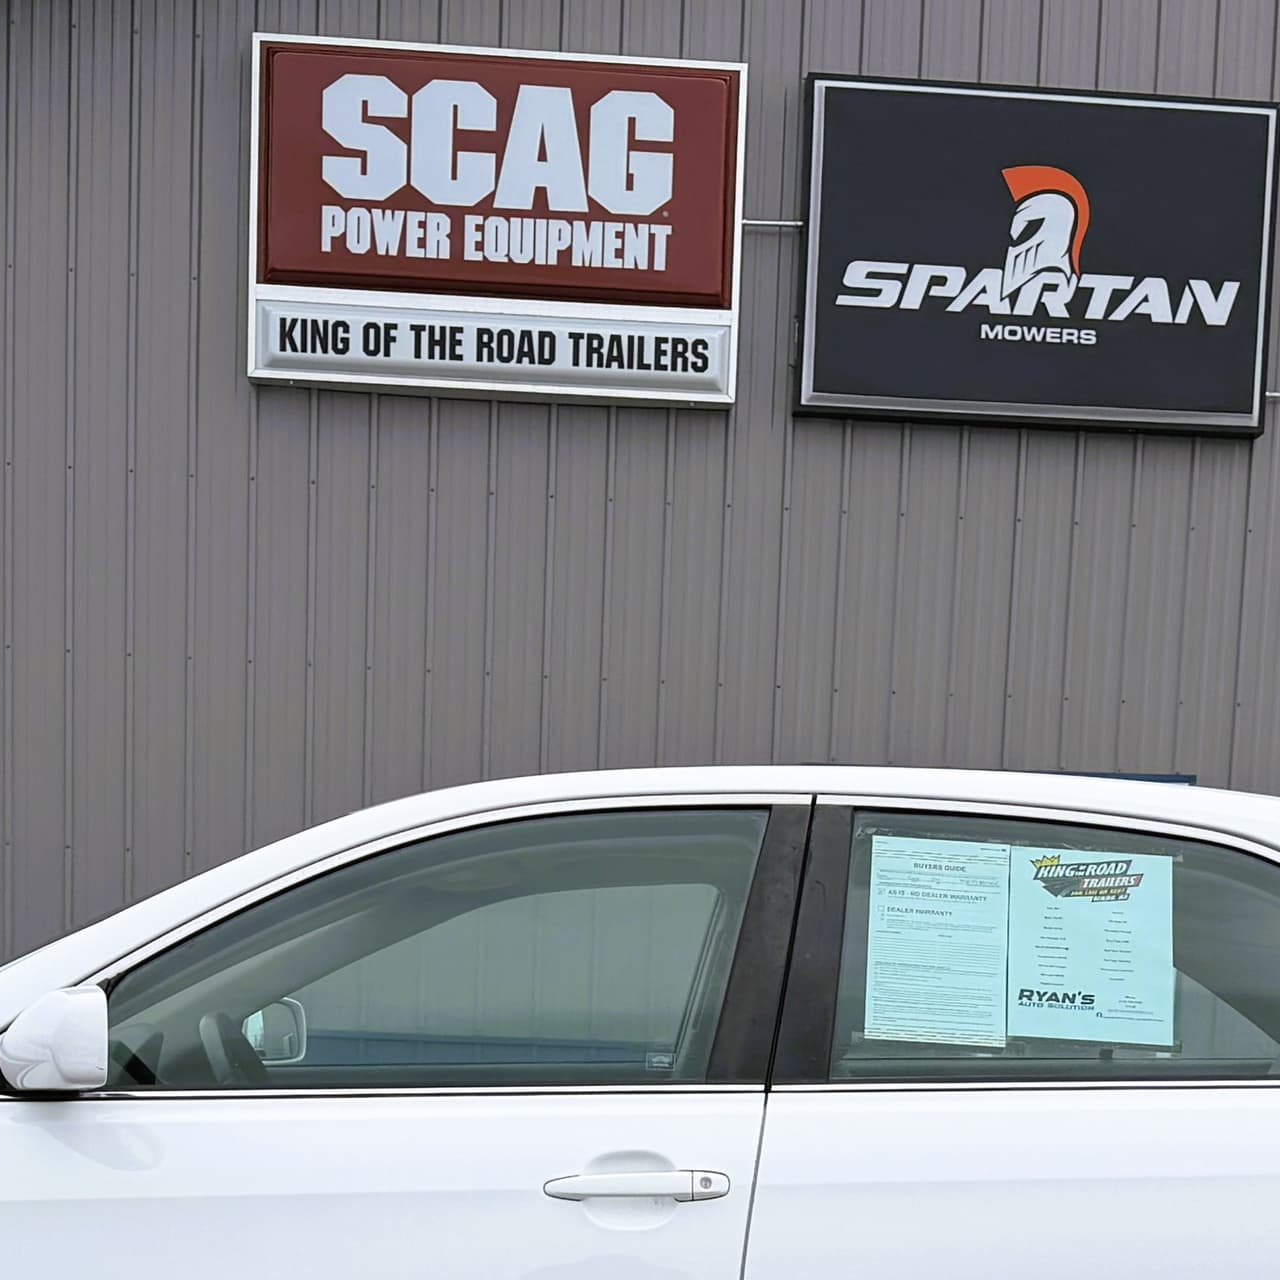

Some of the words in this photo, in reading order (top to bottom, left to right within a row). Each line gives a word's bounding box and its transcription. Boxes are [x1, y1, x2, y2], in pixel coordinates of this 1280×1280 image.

[322, 73, 674, 215] SCAG
[321, 205, 451, 260] POWER
[464, 215, 673, 271] EQUIPMENT
[835, 260, 1240, 326] SPARTAN
[279, 316, 351, 355] KING
[362, 321, 398, 359] OF
[410, 324, 464, 362] THE
[476, 328, 557, 366] ROAD
[568, 332, 710, 374] TRAILERS
[980, 323, 1098, 346] MOWERS
[1037, 864, 1077, 878] KING
[1085, 862, 1128, 876] ROAD
[1082, 875, 1136, 888] TRAILERS
[1018, 988, 1096, 1005] RYAN'S
[1018, 1001, 1044, 1009] AUTO
